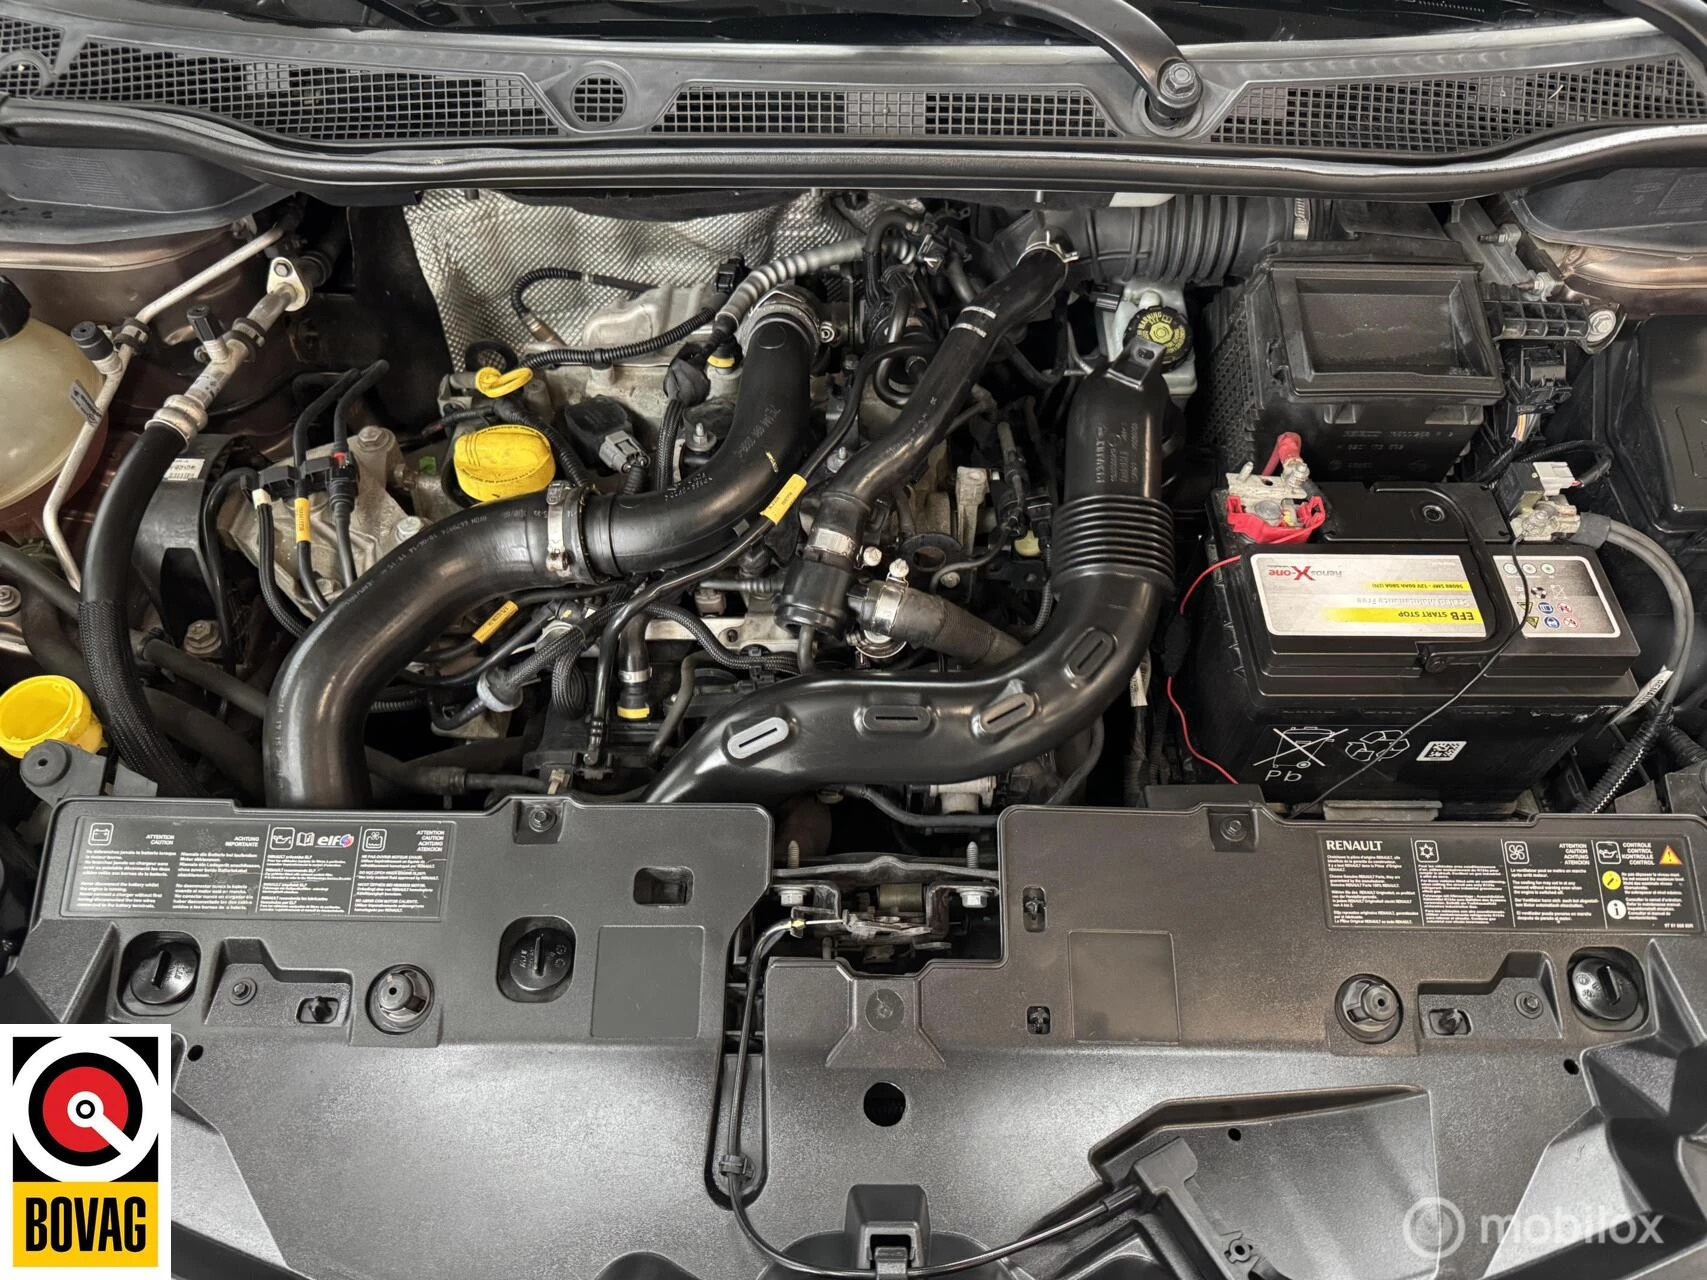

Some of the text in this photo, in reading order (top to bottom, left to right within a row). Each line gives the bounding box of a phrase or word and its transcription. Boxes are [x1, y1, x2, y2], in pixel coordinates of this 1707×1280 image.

[1450, 611, 1475, 621] EFB
[1264, 769, 1302, 782] Pb
[317, 835, 341, 846] elf
[1325, 840, 1383, 851] RENAULT
